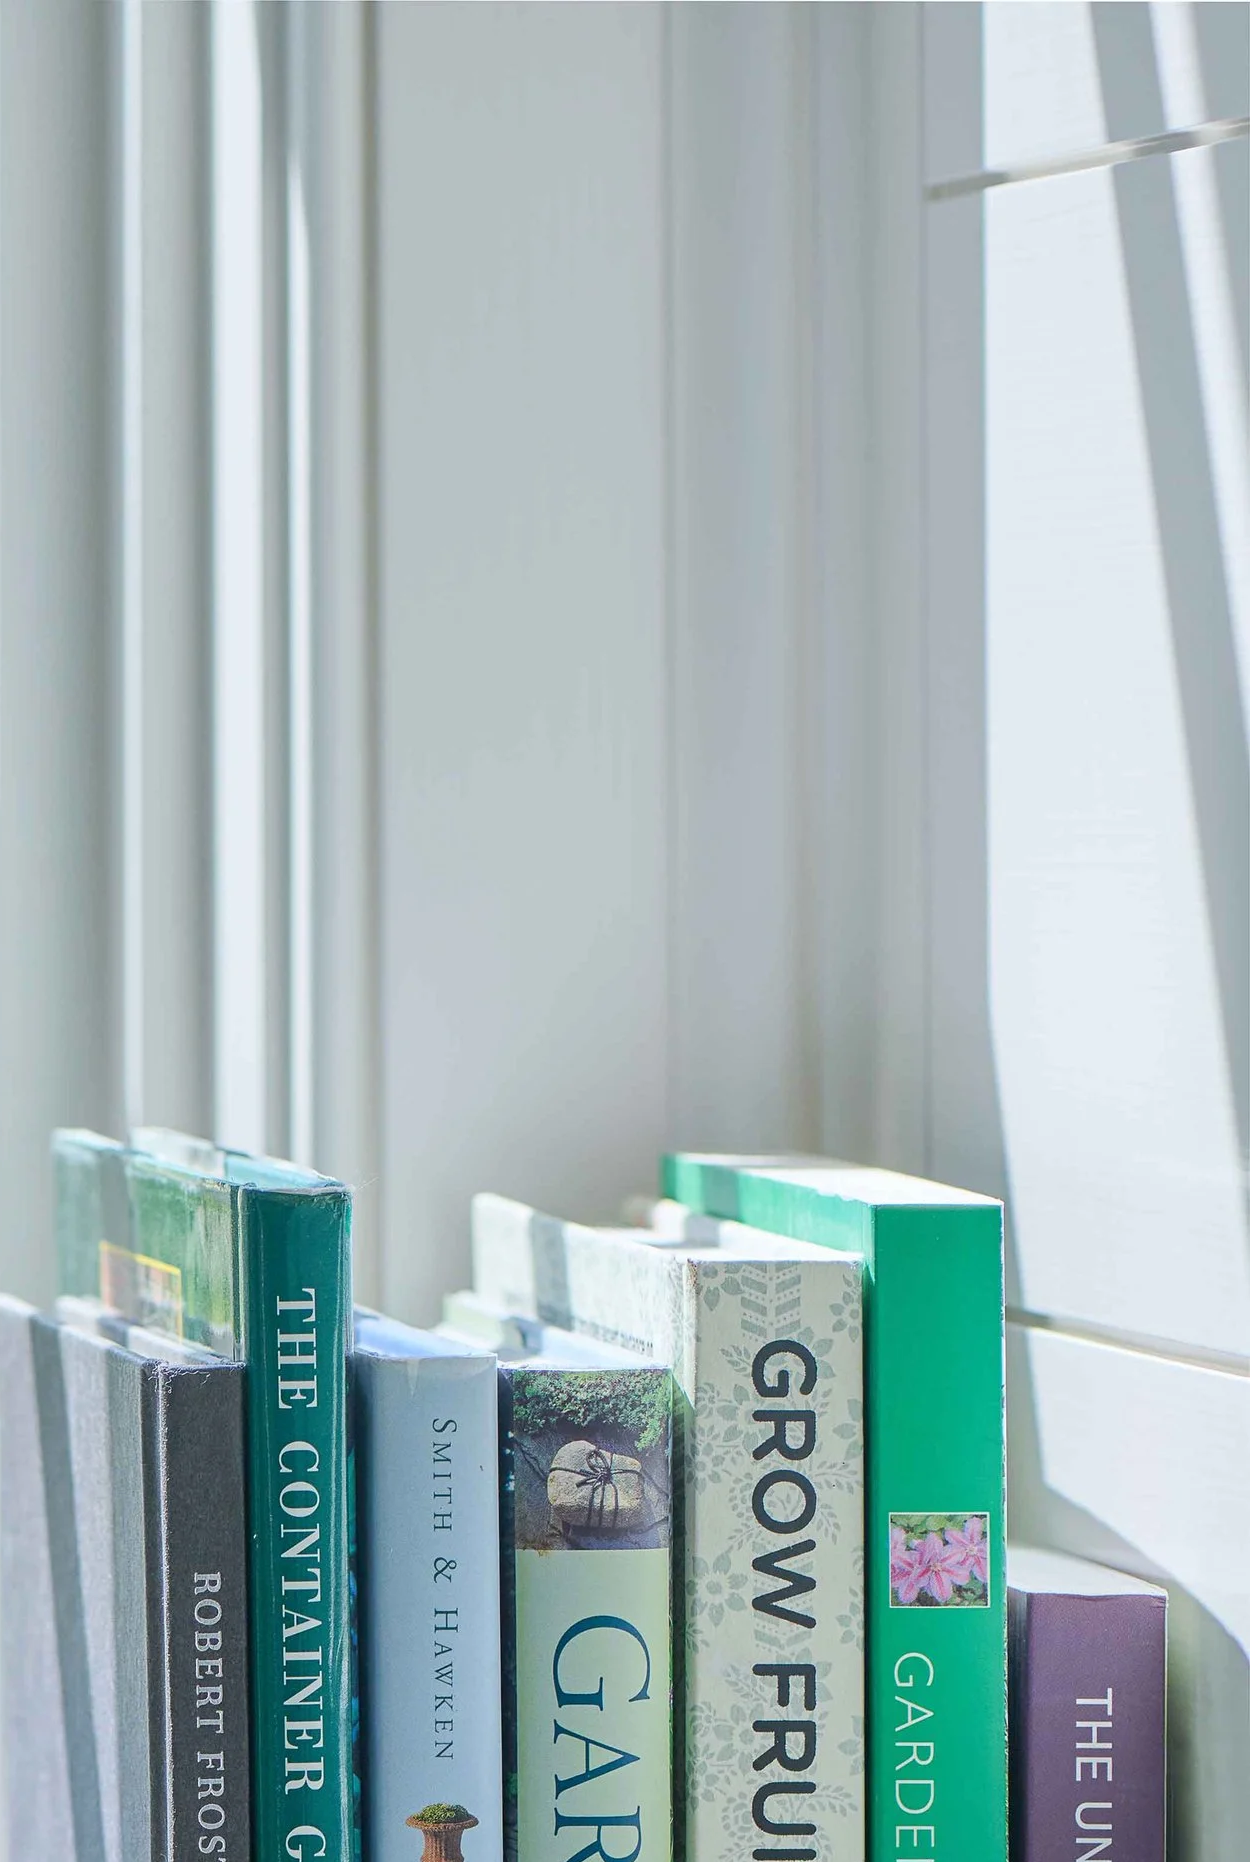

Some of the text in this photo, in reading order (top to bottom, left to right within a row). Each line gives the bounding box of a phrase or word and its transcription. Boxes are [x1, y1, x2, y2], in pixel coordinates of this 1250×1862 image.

[277, 1288, 317, 1408] THE
[433, 1419, 458, 1759] SMITH & HAWKEN
[751, 1340, 817, 1628] GROW
[194, 1572, 224, 1733] ROBERT
[279, 1441, 326, 1794] CONTAINER
[1076, 1688, 1112, 1781] THE
